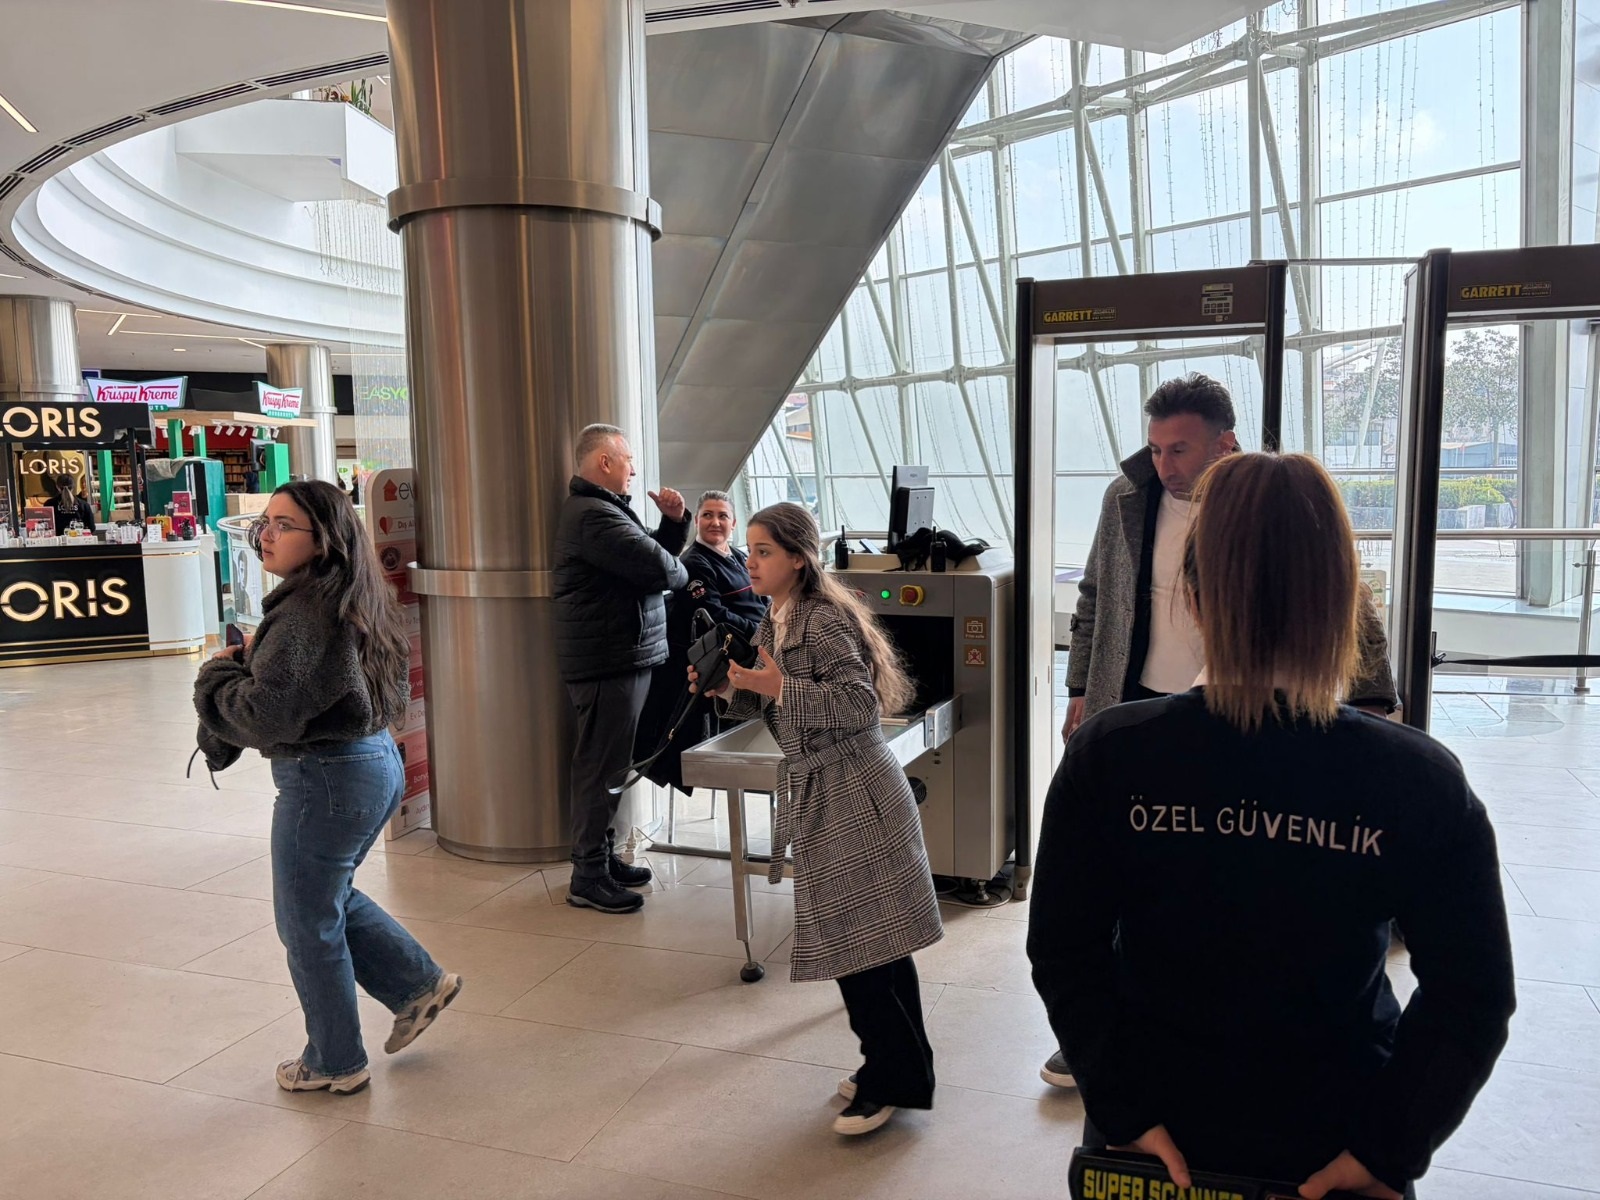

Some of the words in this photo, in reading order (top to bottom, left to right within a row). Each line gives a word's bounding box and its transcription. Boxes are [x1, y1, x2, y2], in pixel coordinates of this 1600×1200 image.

[1461, 284, 1522, 299] GARRETT
[1043, 309, 1092, 323] GARRETT
[97, 385, 138, 403] Krispy
[139, 385, 179, 401] Kreme
[20, 459, 80, 475] LORIS
[1129, 794, 1205, 833] ÖZEL
[1216, 798, 1383, 857] GÜVENLİK
[1083, 1168, 1144, 1200] SUPER
